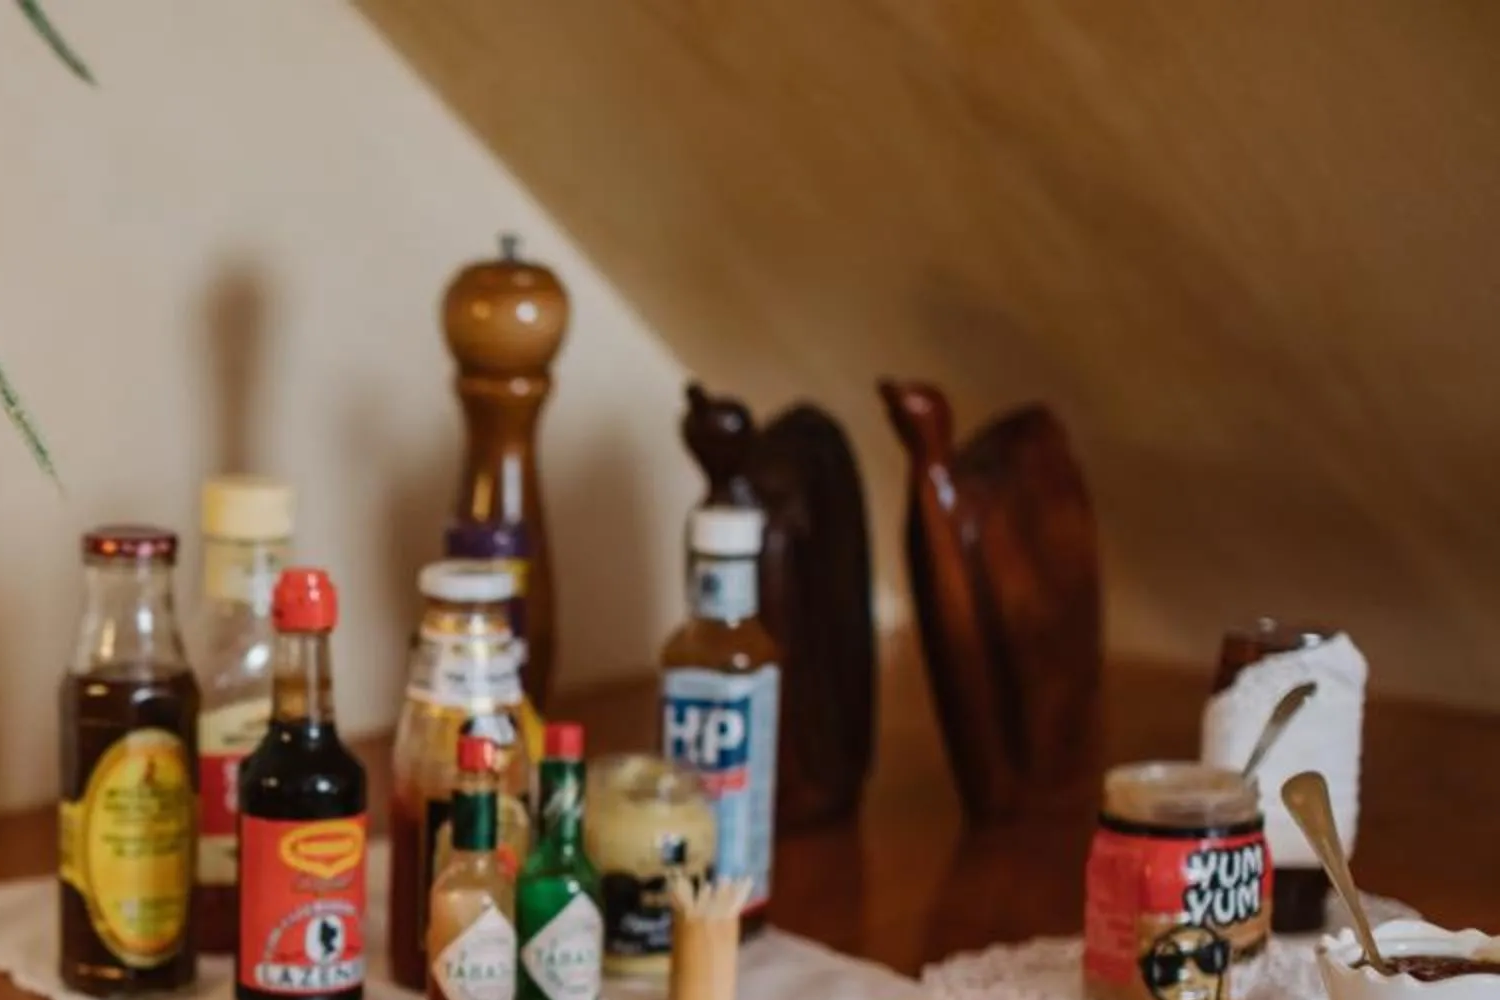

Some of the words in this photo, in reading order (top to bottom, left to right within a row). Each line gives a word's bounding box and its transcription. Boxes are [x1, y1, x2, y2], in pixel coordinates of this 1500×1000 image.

[663, 705, 745, 764] HP
[1186, 845, 1264, 890] YUM
[1186, 882, 1260, 925] YUM
